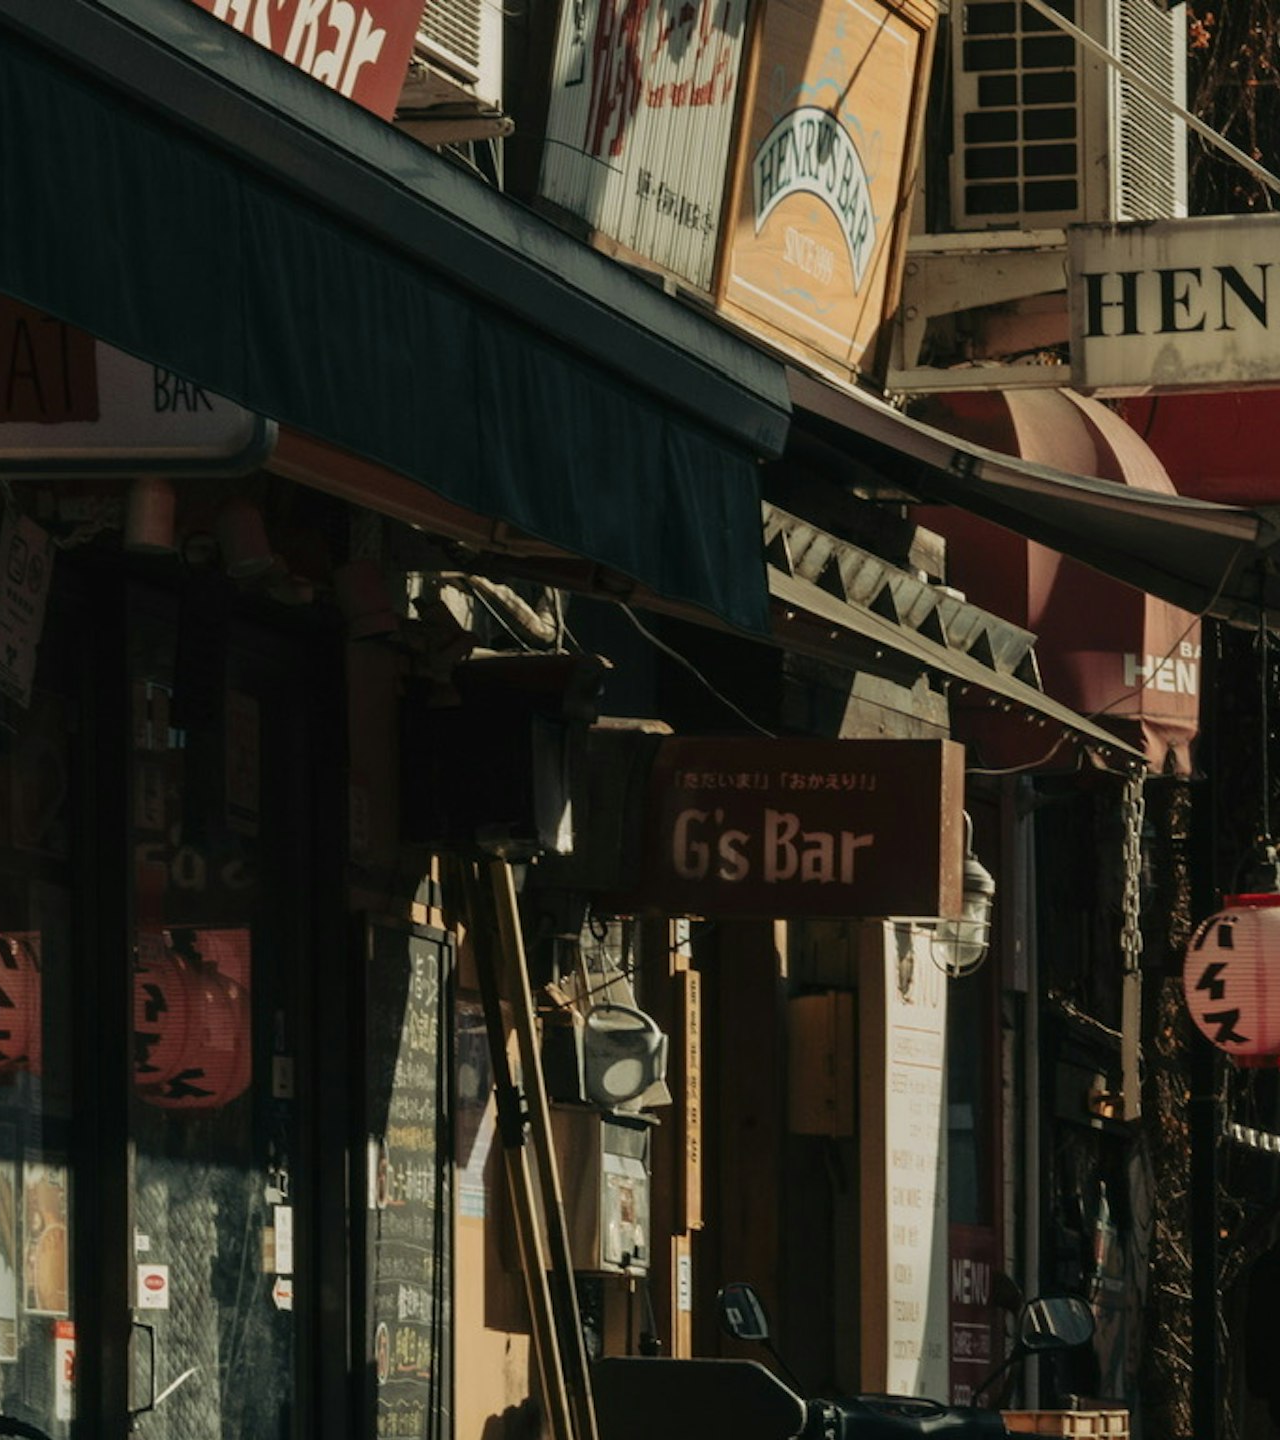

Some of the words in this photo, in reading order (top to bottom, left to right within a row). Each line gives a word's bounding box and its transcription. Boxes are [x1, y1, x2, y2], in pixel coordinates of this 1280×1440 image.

[837, 147, 870, 281] BAR
[673, 807, 751, 882] G's
[763, 807, 875, 885] Bar
[1194, 915, 1250, 1044] バイス
[952, 1258, 991, 1304] MENU
